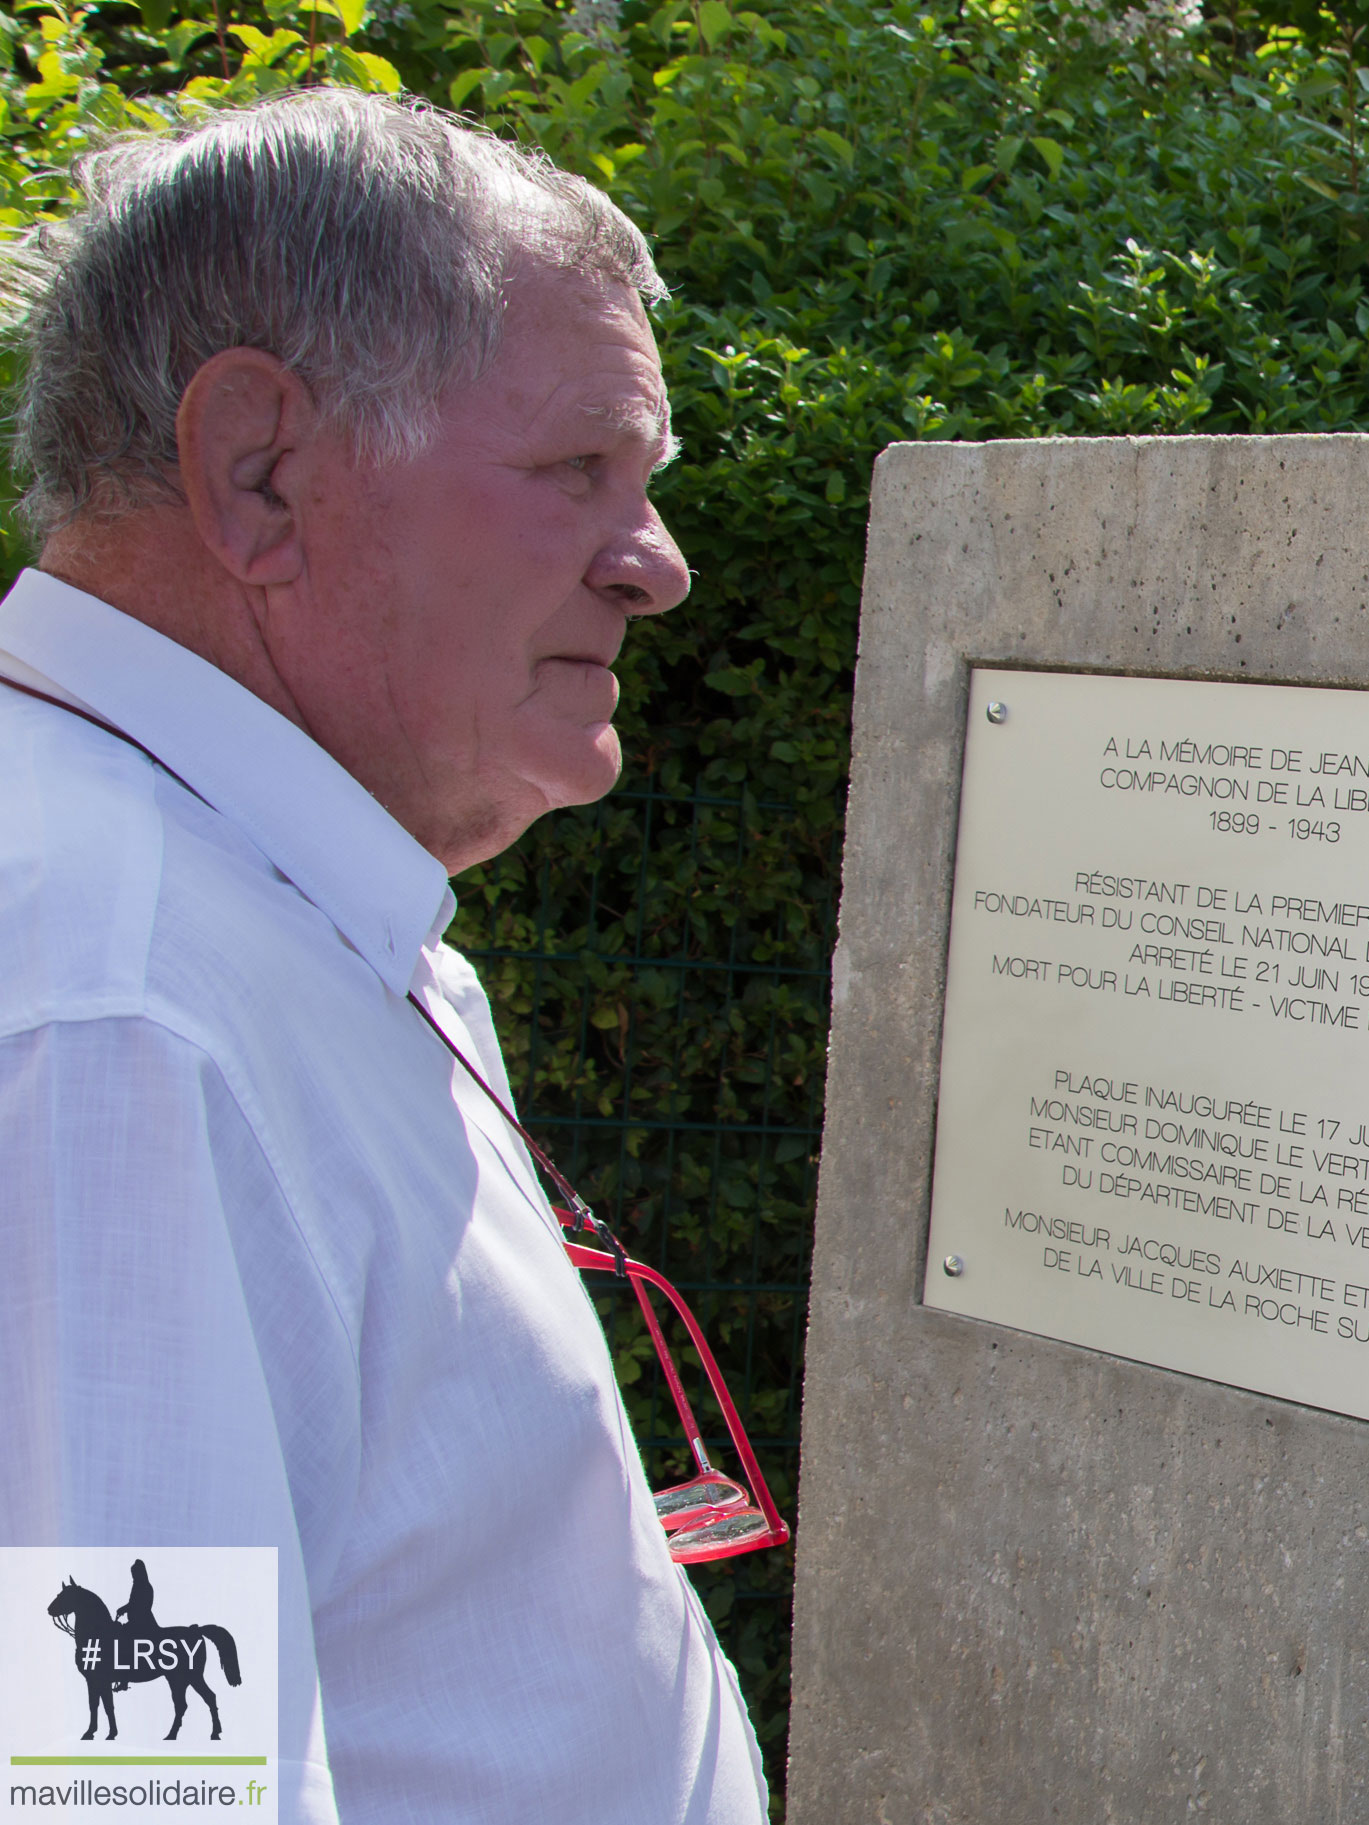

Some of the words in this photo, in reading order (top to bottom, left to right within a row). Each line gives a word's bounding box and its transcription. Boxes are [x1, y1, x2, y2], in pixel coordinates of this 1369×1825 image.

[1100, 767, 1250, 801] COMPAGNON
[1256, 780, 1290, 805] DE
[1296, 784, 1326, 808] LA
[1103, 736, 1119, 758] A
[1125, 737, 1153, 760] LA
[1159, 737, 1264, 769] MÉMOIRE
[1270, 748, 1303, 773] DE
[1209, 810, 1260, 835] 1899
[1287, 818, 1341, 844] 1943
[974, 890, 1095, 926] FONDATEUR
[1101, 906, 1133, 931] DU
[1140, 912, 1235, 945] CONSEIL
[1241, 924, 1358, 961] NATIONAL
[1074, 869, 1191, 905] RÉSISTANT
[1196, 886, 1229, 911] DE
[1234, 891, 1263, 916] LA
[992, 954, 1053, 982] MORT
[1057, 963, 1118, 993] POUR
[1124, 973, 1151, 998] LA
[1158, 978, 1245, 1012] LIBERTÉ
[1269, 994, 1361, 1030] VICTIME
[1128, 943, 1215, 975] ARRETÉ
[1220, 955, 1249, 980] LE
[1255, 960, 1280, 984] 21
[1287, 965, 1340, 993] JUIN
[1030, 1096, 1138, 1136] MONSIEUR
[1144, 1118, 1270, 1162] DOMINIQUE
[1276, 1143, 1305, 1169] LE
[1054, 1069, 1139, 1105] PLAQUE
[1144, 1086, 1273, 1130] INAUGURÉE
[1279, 1110, 1308, 1136] LE
[1317, 1118, 1341, 1141] 17
[1028, 1126, 1095, 1158] ETANT
[1100, 1142, 1253, 1192] COMMISSAIRE
[1259, 1172, 1293, 1200] DE
[1299, 1180, 1329, 1208] LA
[1062, 1164, 1093, 1190] DU
[1099, 1172, 1261, 1225] DÉPARTEMENT
[1267, 1207, 1300, 1235] DE
[1306, 1215, 1337, 1243] LA
[1004, 1207, 1111, 1250] MONSIEUR
[1116, 1234, 1221, 1275] JACQUES
[1227, 1259, 1336, 1302] AUXIETTE
[1043, 1247, 1072, 1273] DE
[1077, 1255, 1104, 1280] LA
[1111, 1263, 1165, 1295] VILLE
[1171, 1277, 1203, 1304] DE
[1208, 1285, 1237, 1313] LA
[1244, 1294, 1330, 1334] ROCHE
